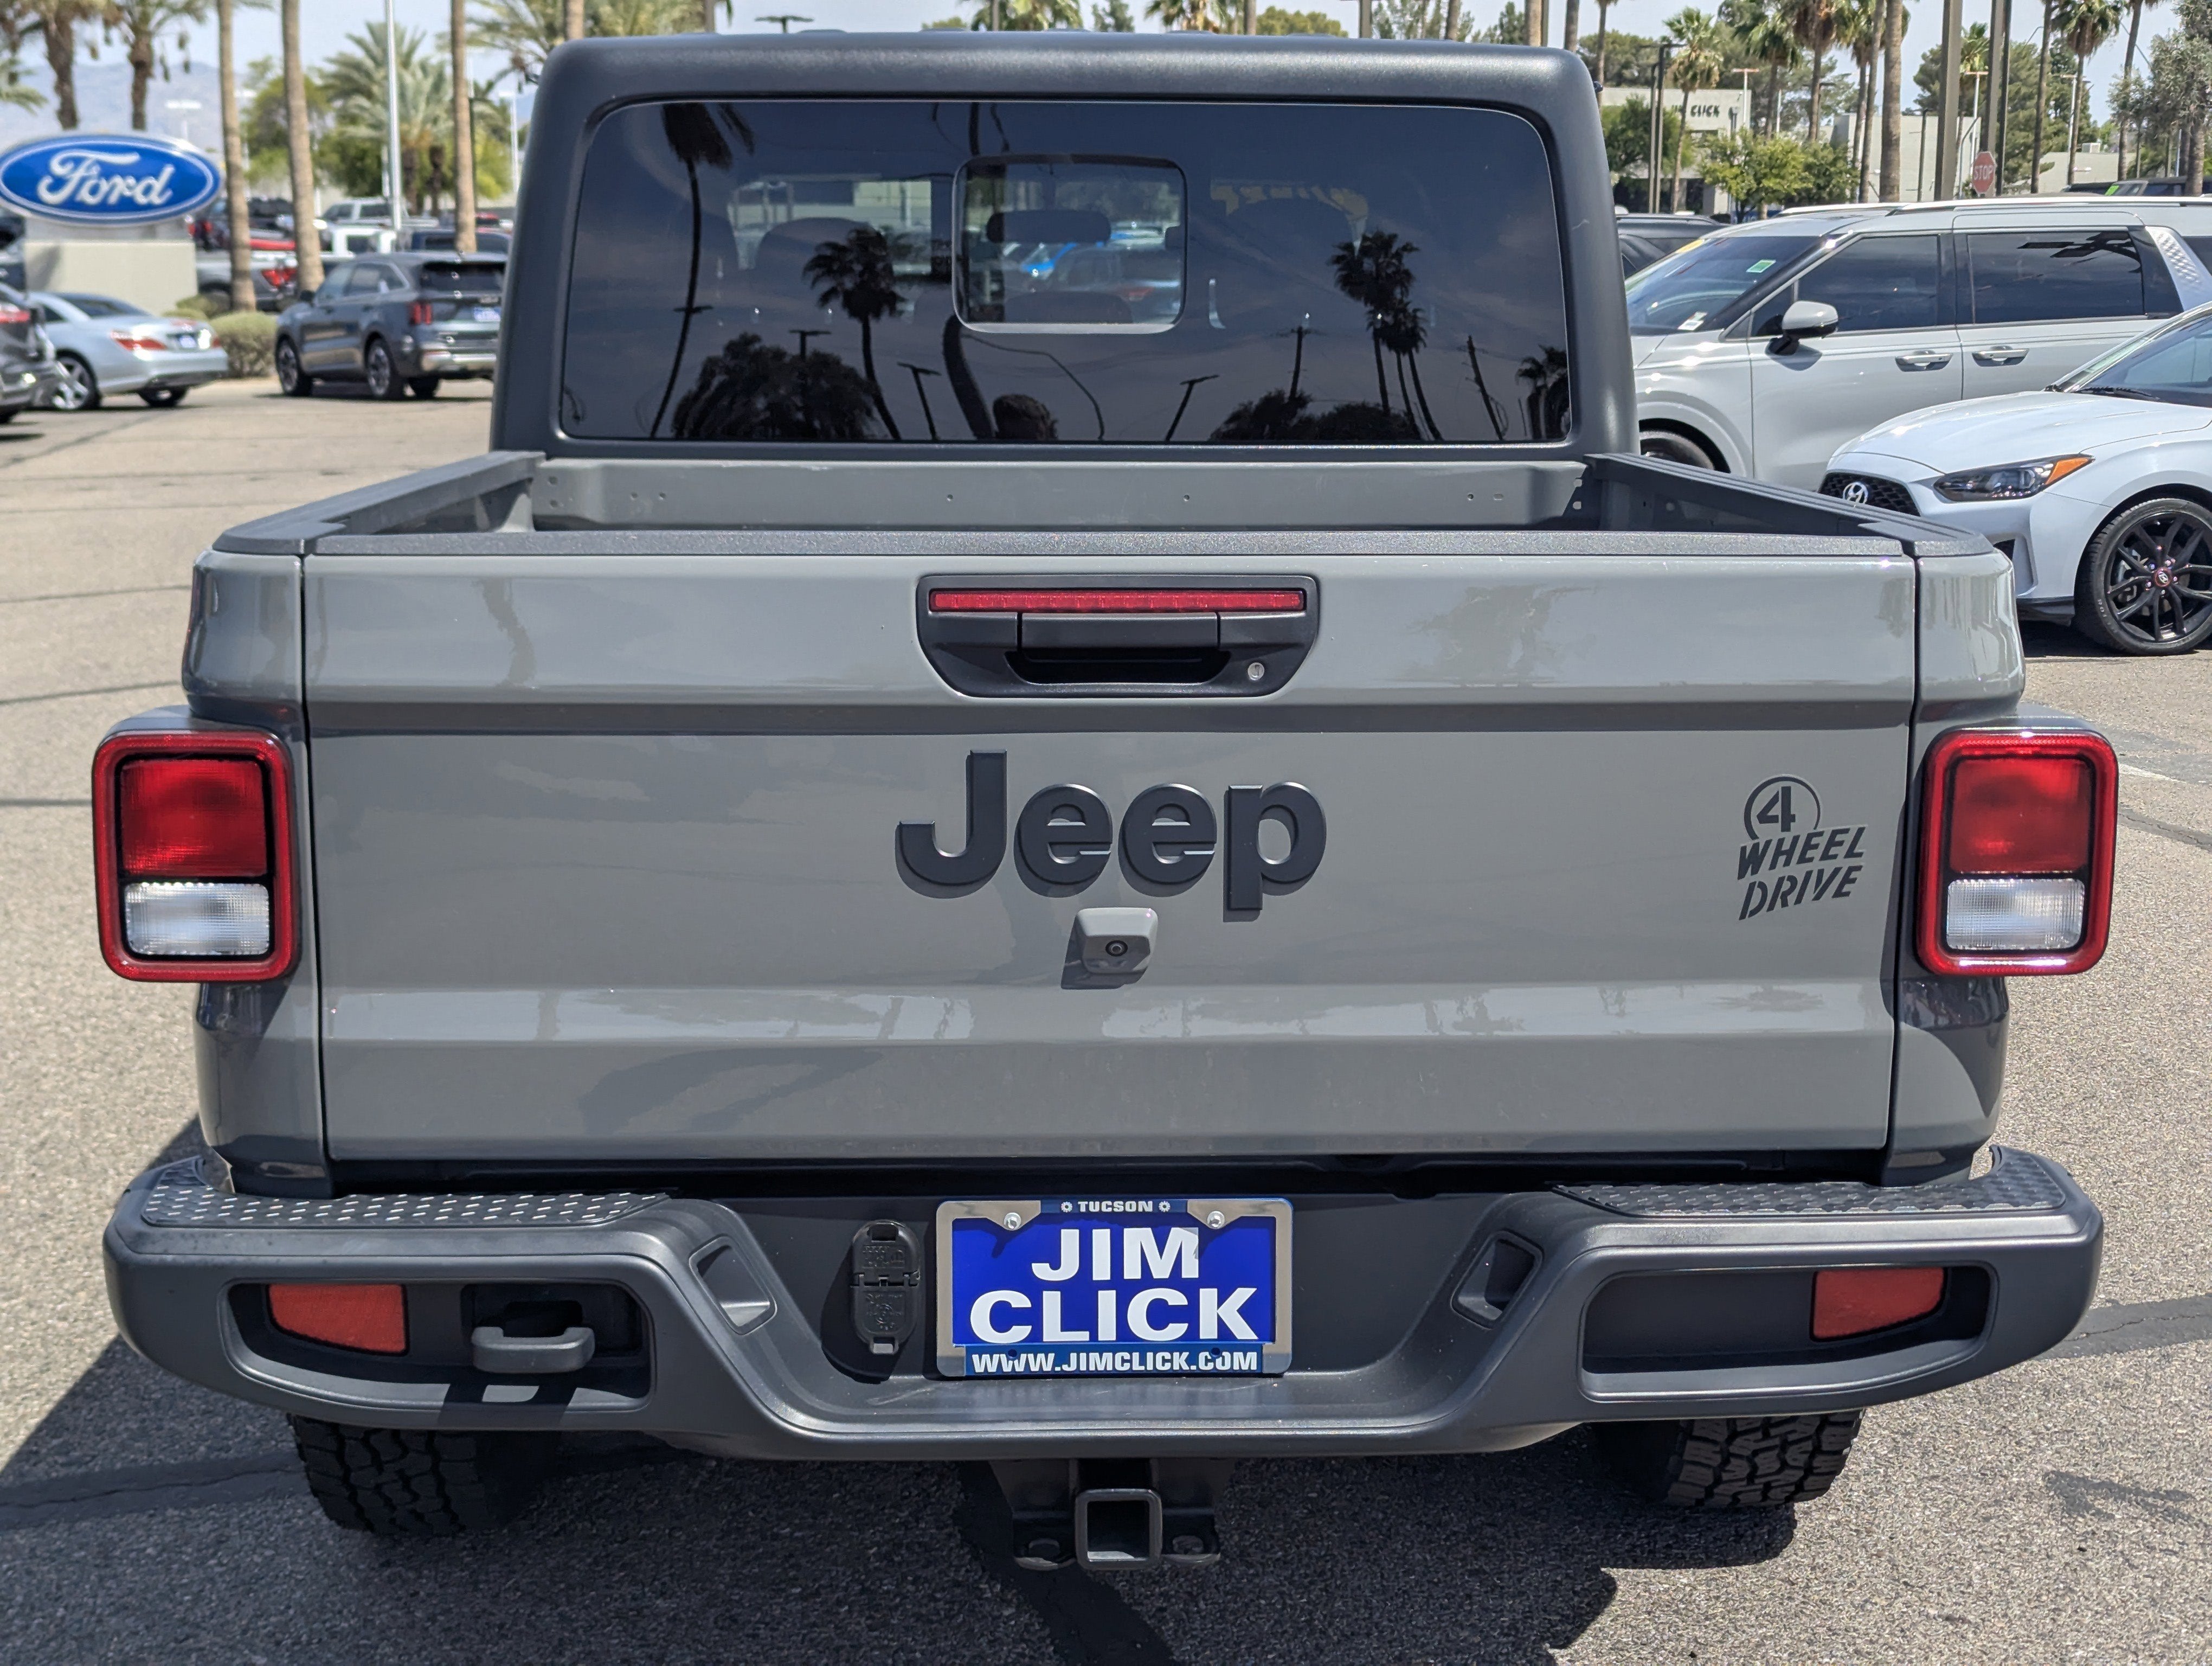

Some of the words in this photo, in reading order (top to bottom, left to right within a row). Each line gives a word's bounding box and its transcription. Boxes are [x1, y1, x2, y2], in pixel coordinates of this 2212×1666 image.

[37, 149, 175, 205] Ford
[1974, 165, 1993, 180] STOP
[896, 749, 1327, 911] Jeep
[1757, 786, 1796, 832] 4
[1738, 826, 1866, 880] WHEEL
[1738, 865, 1863, 920] DRIVE
[1078, 1200, 1153, 1213] TUCSON
[1031, 1227, 1199, 1281] JIM
[970, 1287, 1258, 1342] CLICK
[972, 1351, 1258, 1374] WWW.JIMCLICK.COM
